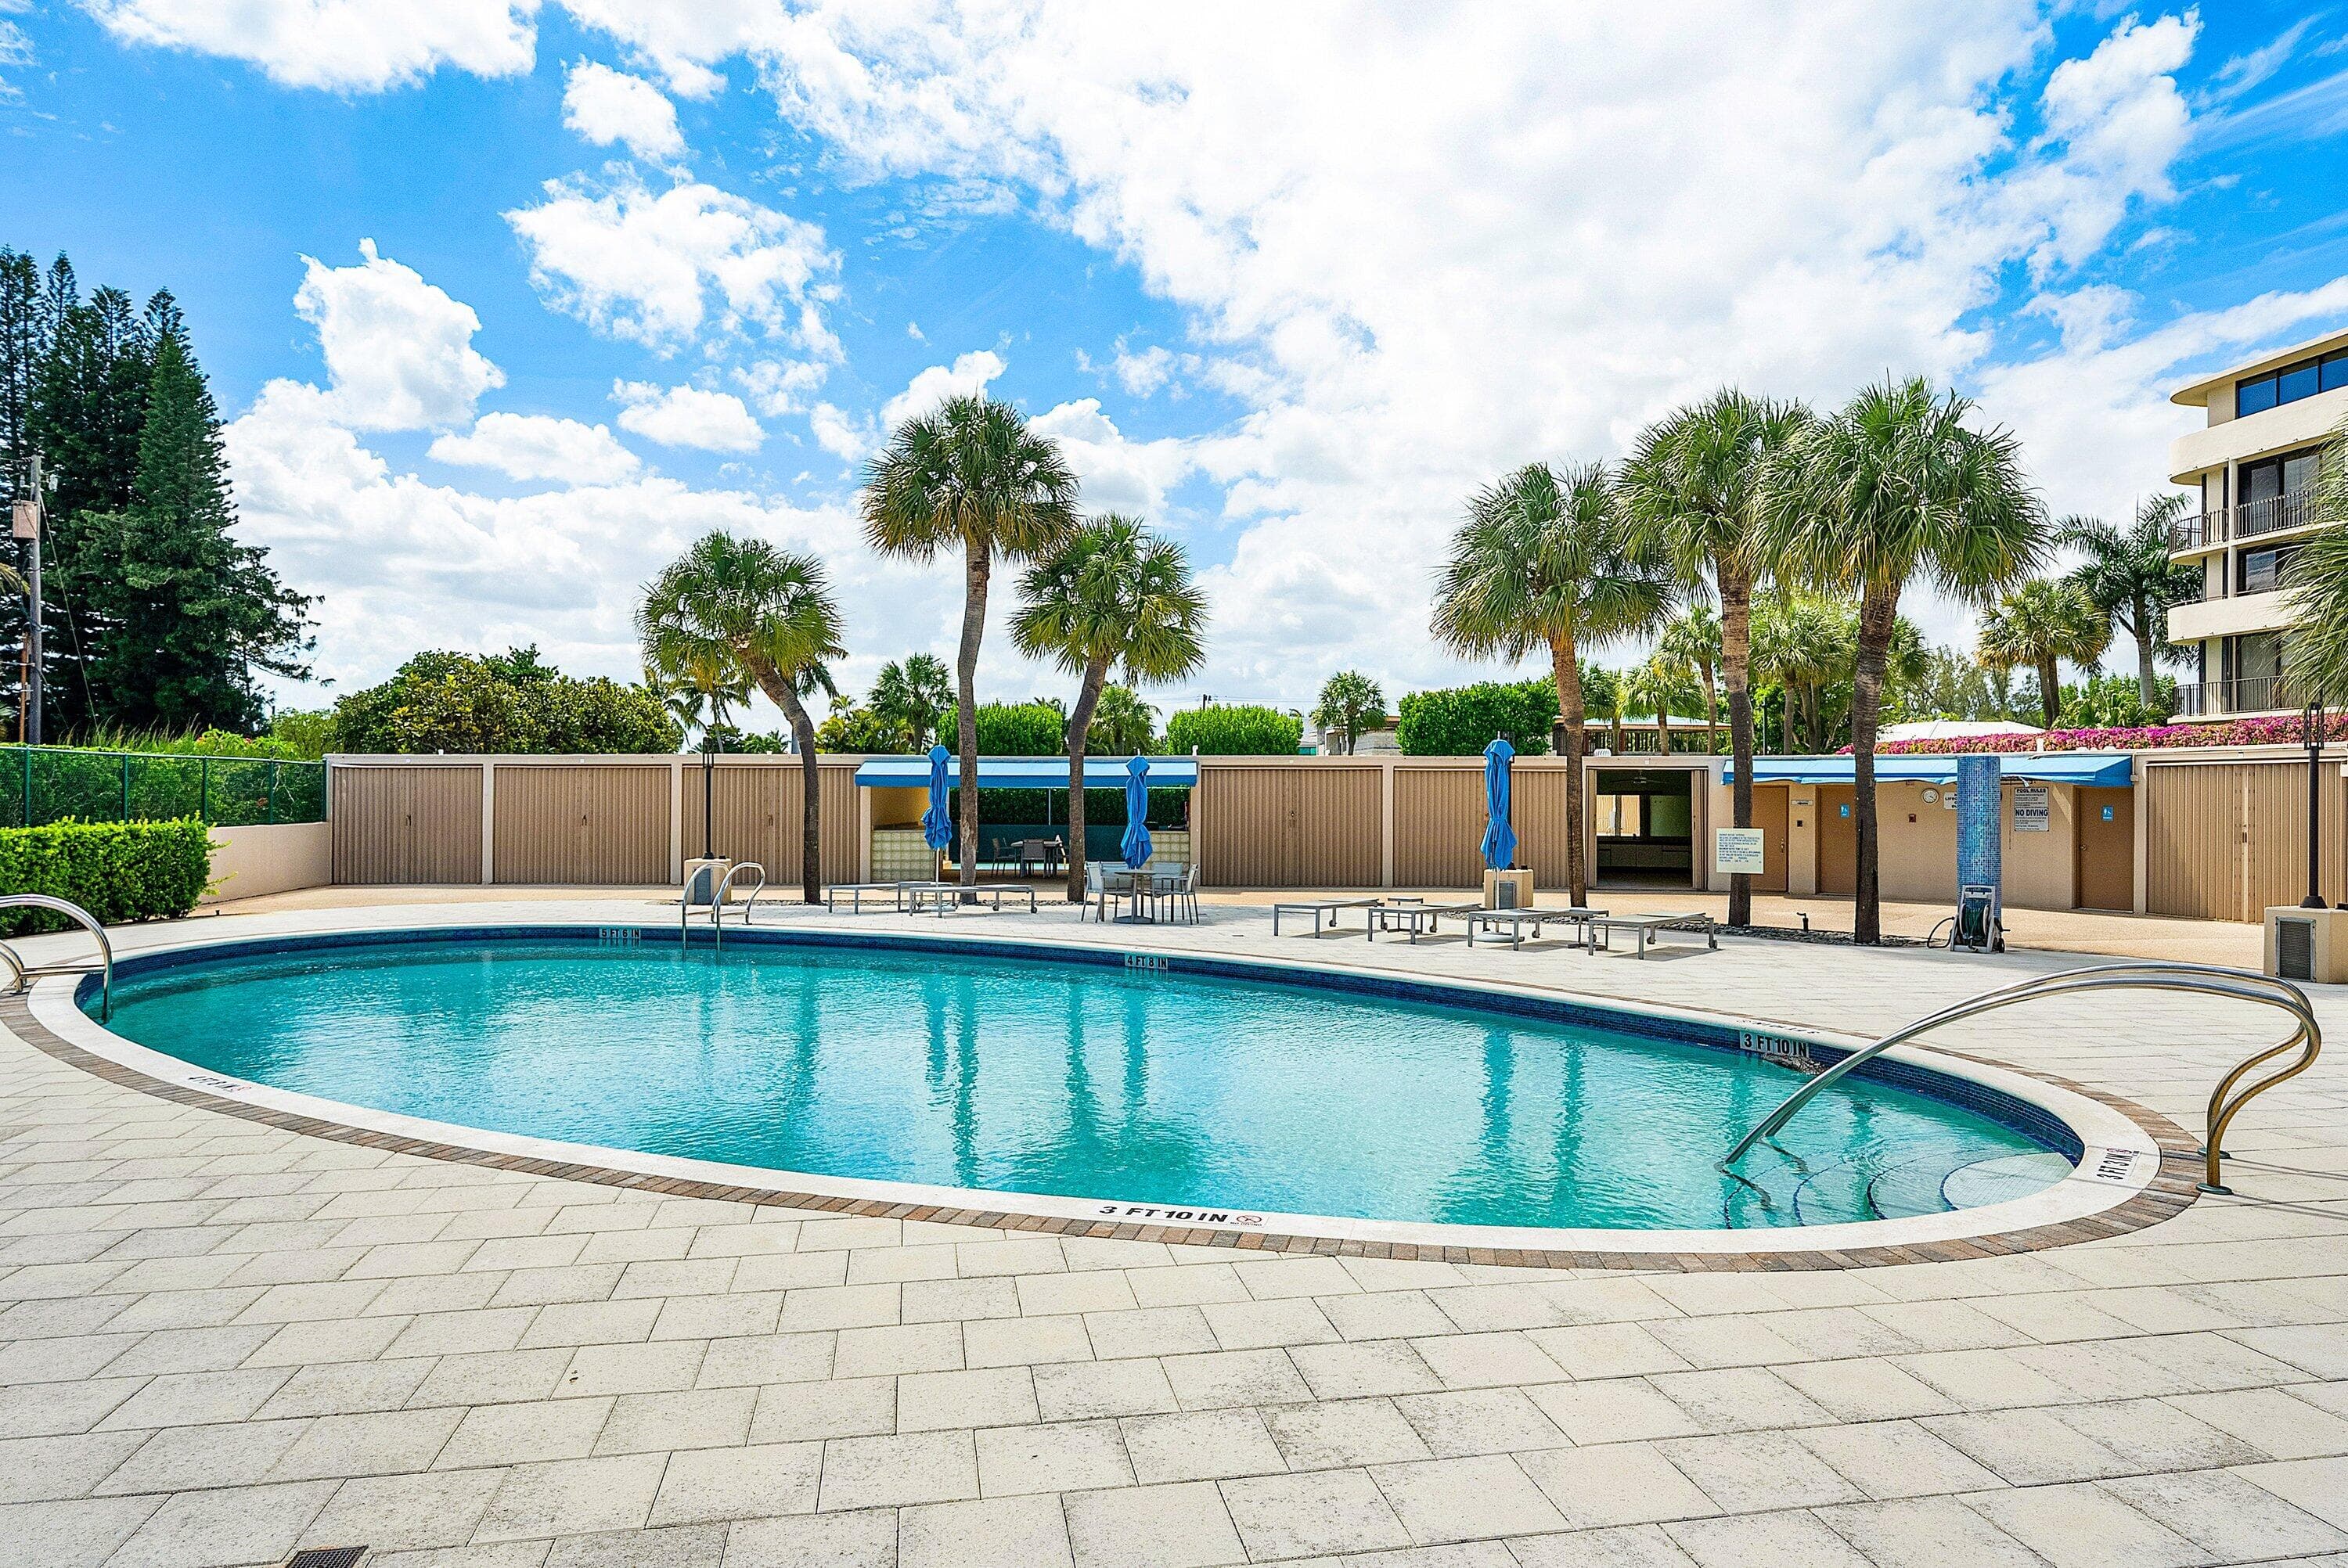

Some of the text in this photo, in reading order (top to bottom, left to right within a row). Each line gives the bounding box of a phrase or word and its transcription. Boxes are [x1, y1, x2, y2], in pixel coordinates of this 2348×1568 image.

[610, 929, 619, 937] FT
[623, 929, 628, 937] 6
[632, 929, 639, 937] IN
[1128, 955, 1166, 968] 4 FT 8 IN
[1744, 1034, 1808, 1057] 3 FT 10 IN
[2098, 1166, 2127, 1174] FT
[1099, 1206, 1229, 1222] 3 FT 10 IN
